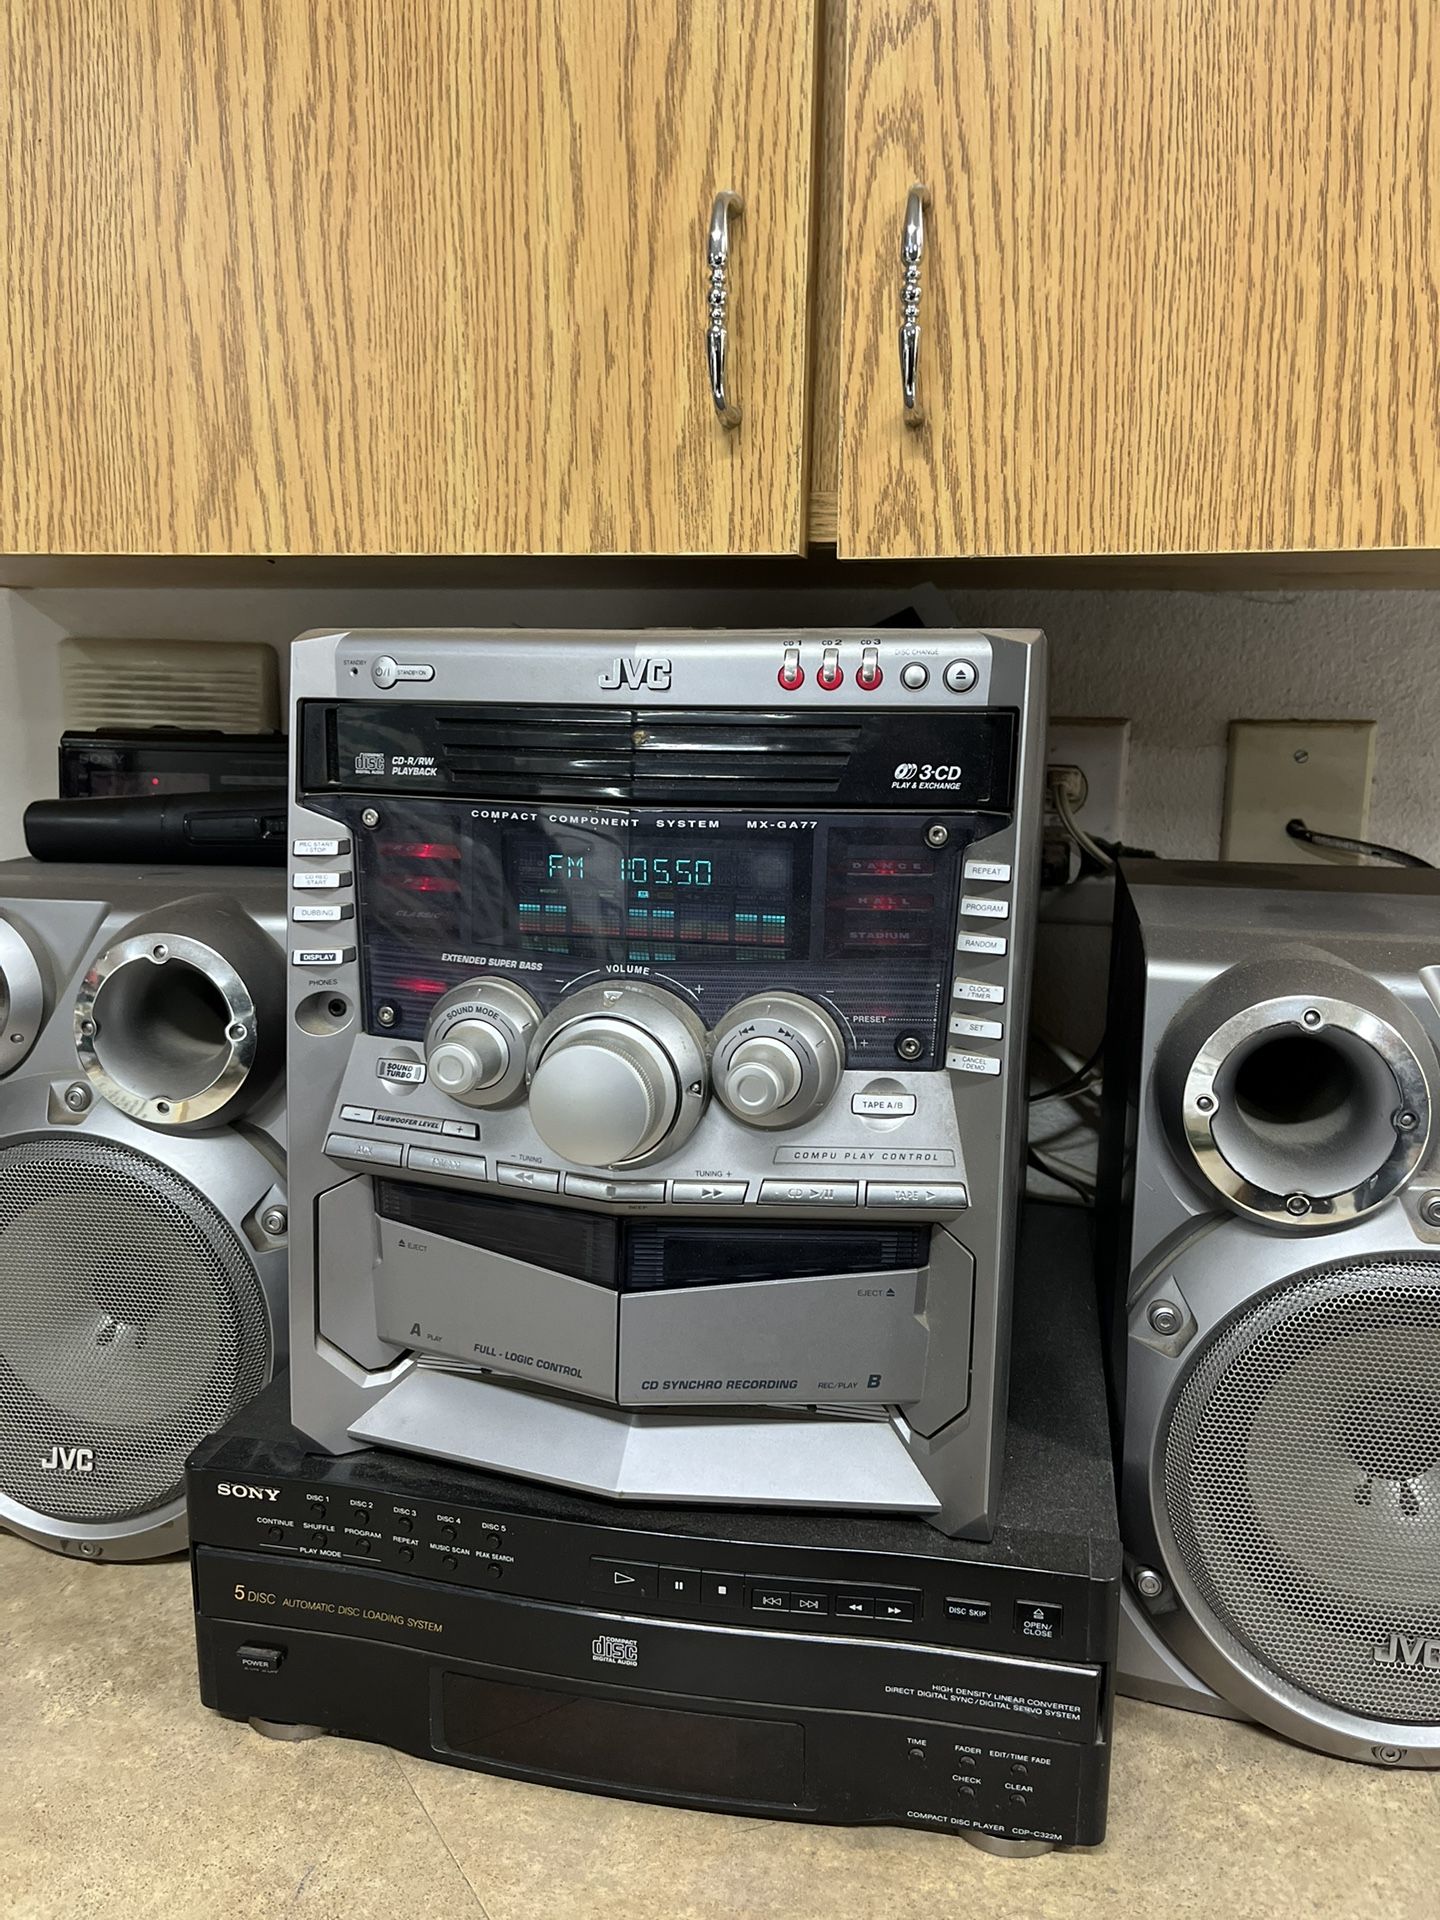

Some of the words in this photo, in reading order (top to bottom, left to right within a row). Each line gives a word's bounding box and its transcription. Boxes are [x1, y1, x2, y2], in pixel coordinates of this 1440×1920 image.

[598, 657, 671, 690] JVC
[79, 753, 125, 765] SONY
[391, 766, 438, 776] PLAYBACK
[891, 781, 911, 790] PLAY
[911, 781, 917, 790] &
[918, 781, 962, 791] EXCHANGE
[471, 809, 538, 822] COMPACT
[549, 814, 640, 827] COMPONENT
[655, 820, 720, 829] SYSTEM
[746, 820, 818, 830] MX-GA77
[549, 854, 584, 879] FM
[620, 857, 712, 886] 105.50
[852, 862, 922, 871] DANCE
[972, 867, 1002, 876] REPEAT
[858, 897, 911, 906] HALL
[301, 909, 334, 917] DUBBING
[966, 902, 1004, 913] PROGRAM
[849, 931, 911, 940] STADIUM
[964, 939, 998, 949] RANDOM
[303, 953, 335, 961] DISPLAY
[441, 953, 487, 966] EXTENDED
[488, 956, 518, 969] SUPER
[518, 959, 544, 971] BASS
[605, 964, 651, 976] VOLUME
[308, 978, 338, 987] PHONES
[445, 1004, 475, 1022] SOUND
[474, 1004, 501, 1021] MODE
[853, 1015, 887, 1023] PRESET
[969, 1024, 984, 1032] SET
[962, 1056, 987, 1066] CANCEL
[386, 1062, 414, 1072] SOUND
[386, 1069, 412, 1079] TURBO
[862, 1101, 885, 1109] TAPE
[886, 1101, 904, 1109] A/B
[376, 1114, 418, 1126] SUBWOOFER
[418, 1120, 440, 1129] LEVEL
[518, 1153, 543, 1164] TUNING
[794, 1151, 838, 1160] COMPU
[844, 1152, 875, 1161] PLAY
[881, 1152, 939, 1161] CONTROL
[695, 1170, 723, 1178] TUNING
[787, 1188, 803, 1199] CD
[895, 1190, 919, 1201] TAPE
[407, 1242, 428, 1252] EJECT
[857, 1289, 883, 1297] EJECT
[410, 1322, 422, 1337] A
[426, 1333, 443, 1342] PLAY
[473, 1343, 497, 1357] FULL
[504, 1351, 534, 1367] LOGIC
[535, 1358, 583, 1379] CONTROL
[641, 1380, 659, 1391] CD
[662, 1379, 723, 1391] SYNCHRO
[726, 1379, 798, 1390] RECORDING
[817, 1381, 859, 1390] REC/PLAY
[866, 1374, 882, 1389] B
[41, 1446, 94, 1472] JVC
[217, 1482, 281, 1502] SONY
[306, 1493, 324, 1502] DISC
[349, 1499, 367, 1509] DISC
[368, 1501, 374, 1510] 2
[393, 1506, 410, 1516] DISC
[411, 1509, 417, 1517] 3
[256, 1516, 295, 1528] CONTINUE
[436, 1513, 454, 1523] DISC
[455, 1516, 462, 1525] 4
[303, 1521, 336, 1533] SHUFFLE
[481, 1521, 499, 1531] DISC
[500, 1524, 507, 1533] 5
[344, 1527, 382, 1540] PROGRAM
[392, 1535, 419, 1546] REPEAT
[299, 1546, 319, 1556] PLAY
[319, 1549, 342, 1559] MODE
[429, 1542, 451, 1553] MUSIC
[451, 1546, 471, 1556] SCAN
[475, 1550, 491, 1559] PEAK
[491, 1552, 515, 1564] SEARCH
[234, 1584, 246, 1601] 5
[247, 1591, 277, 1606] DISC
[282, 1597, 336, 1614] AUTOMATIC
[338, 1604, 361, 1618] DISC
[362, 1608, 405, 1625] LOADING
[407, 1617, 444, 1633] SYSTEM
[948, 1606, 967, 1616] DISC
[968, 1608, 987, 1618] SKIP
[1023, 1620, 1053, 1631] OPEN/
[1023, 1628, 1053, 1638] CLOSE
[605, 1636, 638, 1646] COMPACT
[592, 1635, 638, 1661] disc
[242, 1658, 269, 1668] POWER
[592, 1655, 617, 1664] DIGITAL
[617, 1659, 638, 1667] AUDIO
[884, 1685, 915, 1696] DIRECT
[917, 1689, 949, 1701] DIGITAL
[950, 1694, 1011, 1710] SYNC/DIGITAL
[1013, 1703, 1043, 1715] SERVO
[1044, 1708, 1081, 1721] SYSTEM
[932, 1684, 954, 1693] HIGH
[955, 1687, 992, 1699] DENSITY
[993, 1693, 1026, 1705] LINEAR
[1027, 1699, 1081, 1713] CONVERTER
[906, 1737, 927, 1746] TIME
[954, 1744, 982, 1755] FADER
[989, 1750, 1029, 1763] EDIT/TIME
[1031, 1756, 1052, 1766] FADE
[952, 1774, 982, 1785] CHECK
[1004, 1782, 1034, 1793] CLEAR
[907, 1810, 948, 1823] COMPACT
[950, 1816, 971, 1827] DISC
[972, 1820, 1005, 1832] PLAYER
[1011, 1827, 1063, 1841] CDP-C322M
